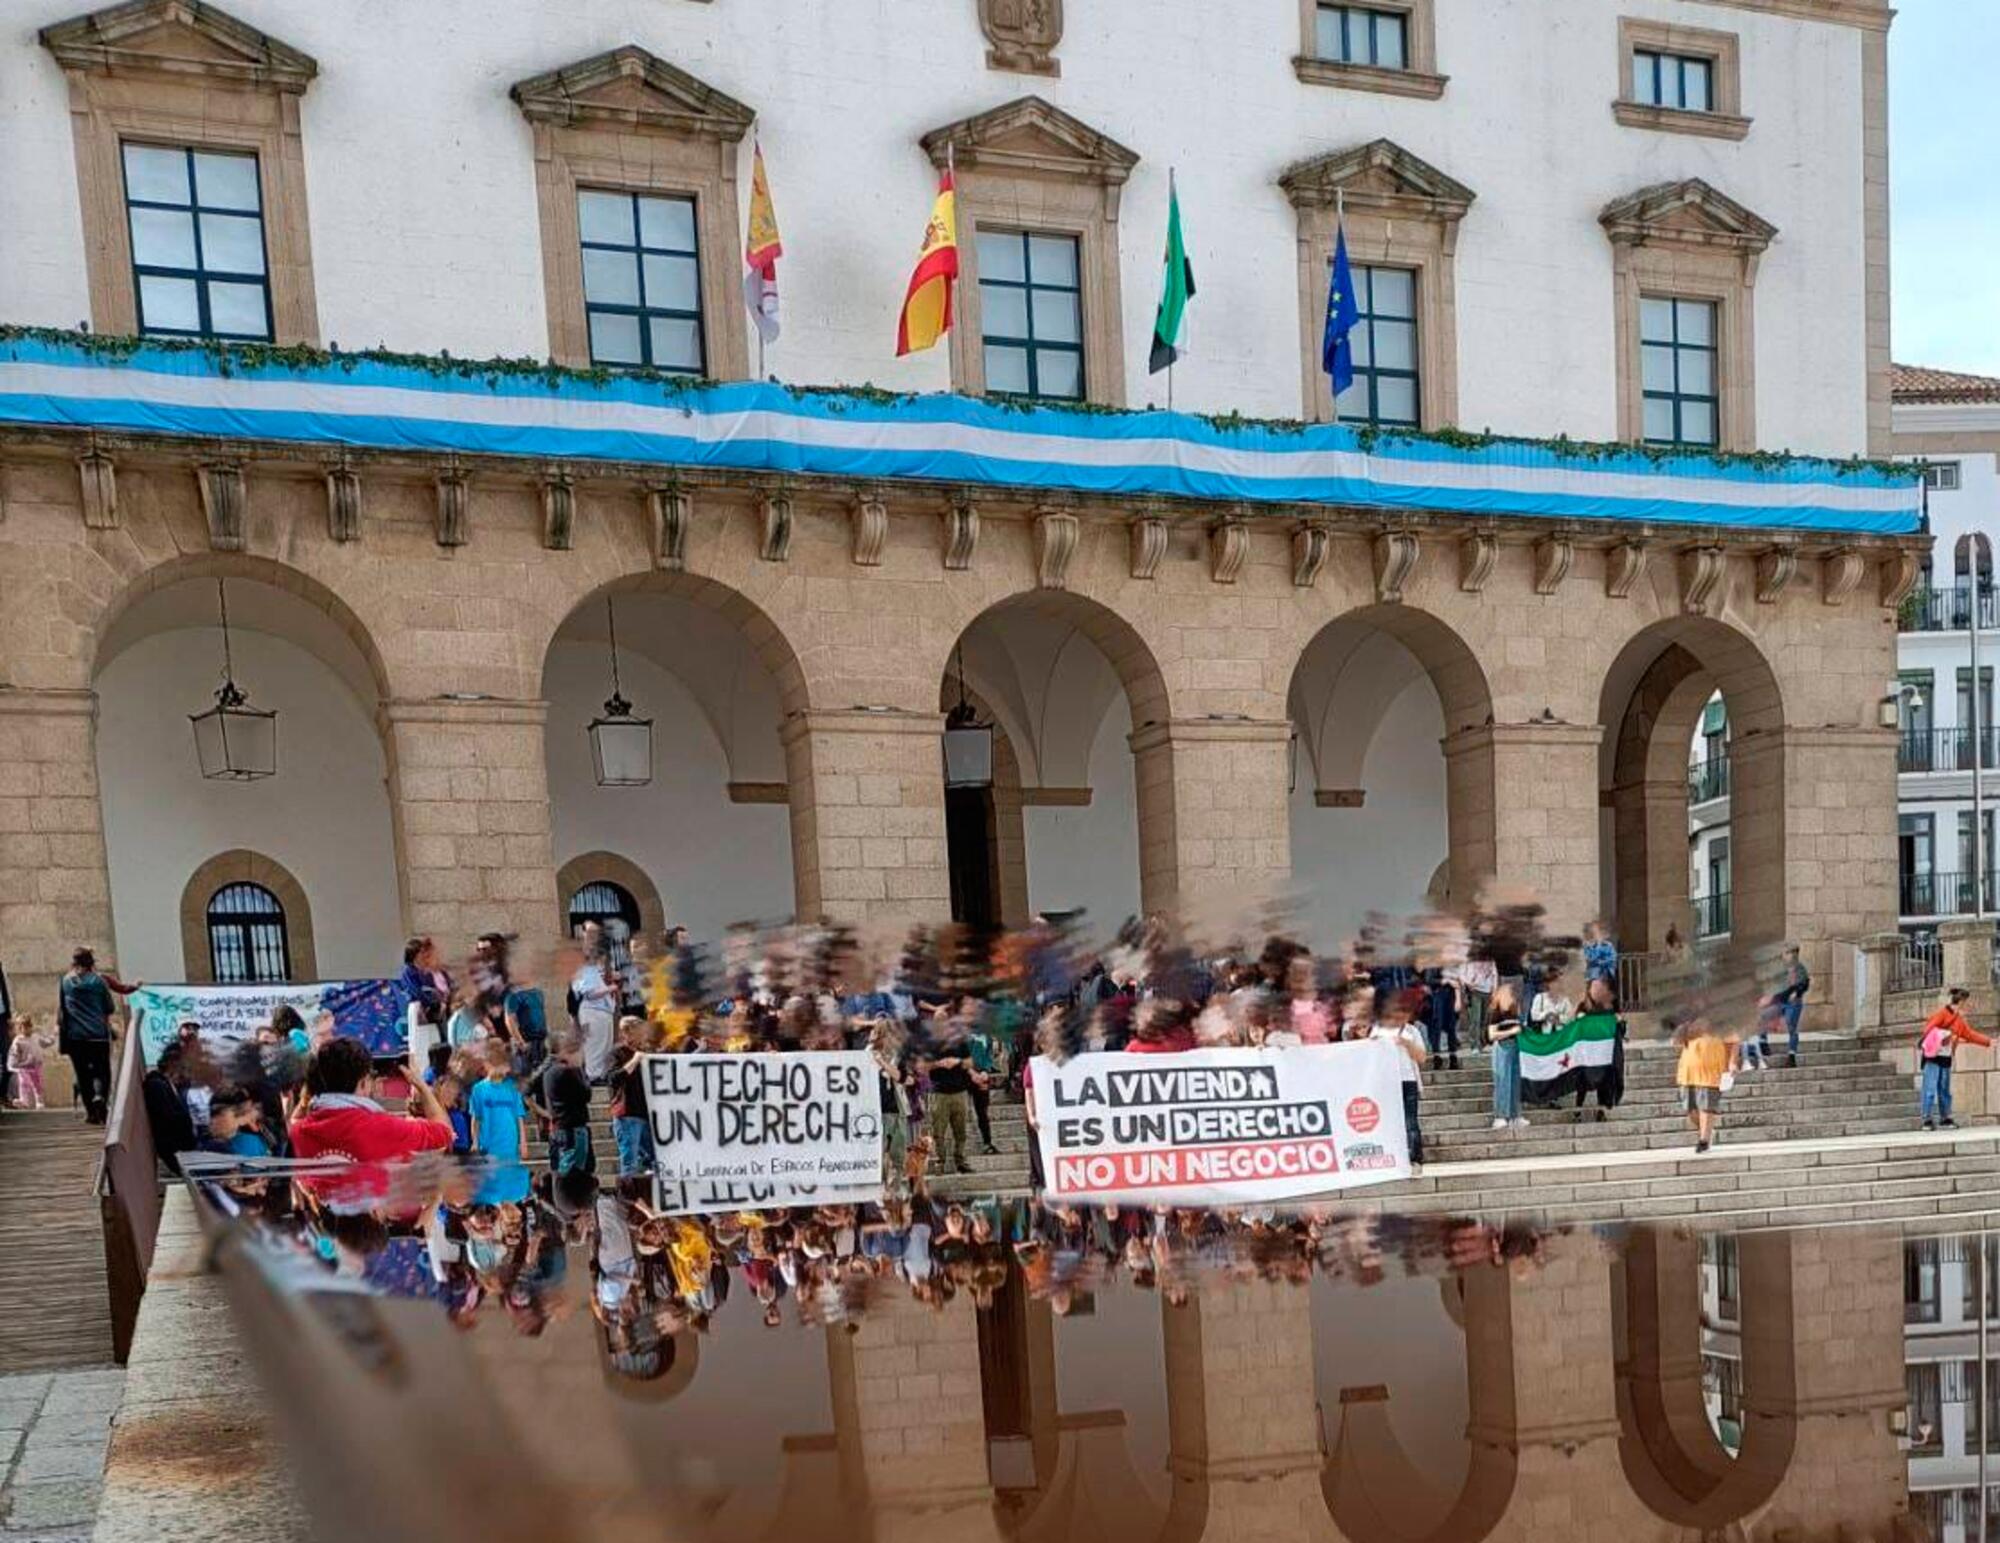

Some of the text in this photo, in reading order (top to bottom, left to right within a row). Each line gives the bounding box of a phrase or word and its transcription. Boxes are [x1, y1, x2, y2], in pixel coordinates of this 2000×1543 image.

[649, 1060, 861, 1101] EL TECHO ES
[1053, 1076, 1106, 1106] LA
[652, 1110, 701, 1146] UN
[1057, 1106, 1325, 1148] ES UN DERECHO
[1057, 1157, 1116, 1191] NO
[1124, 1152, 1178, 1184] UN
[1187, 1144, 1331, 1180] NEGOCIO
